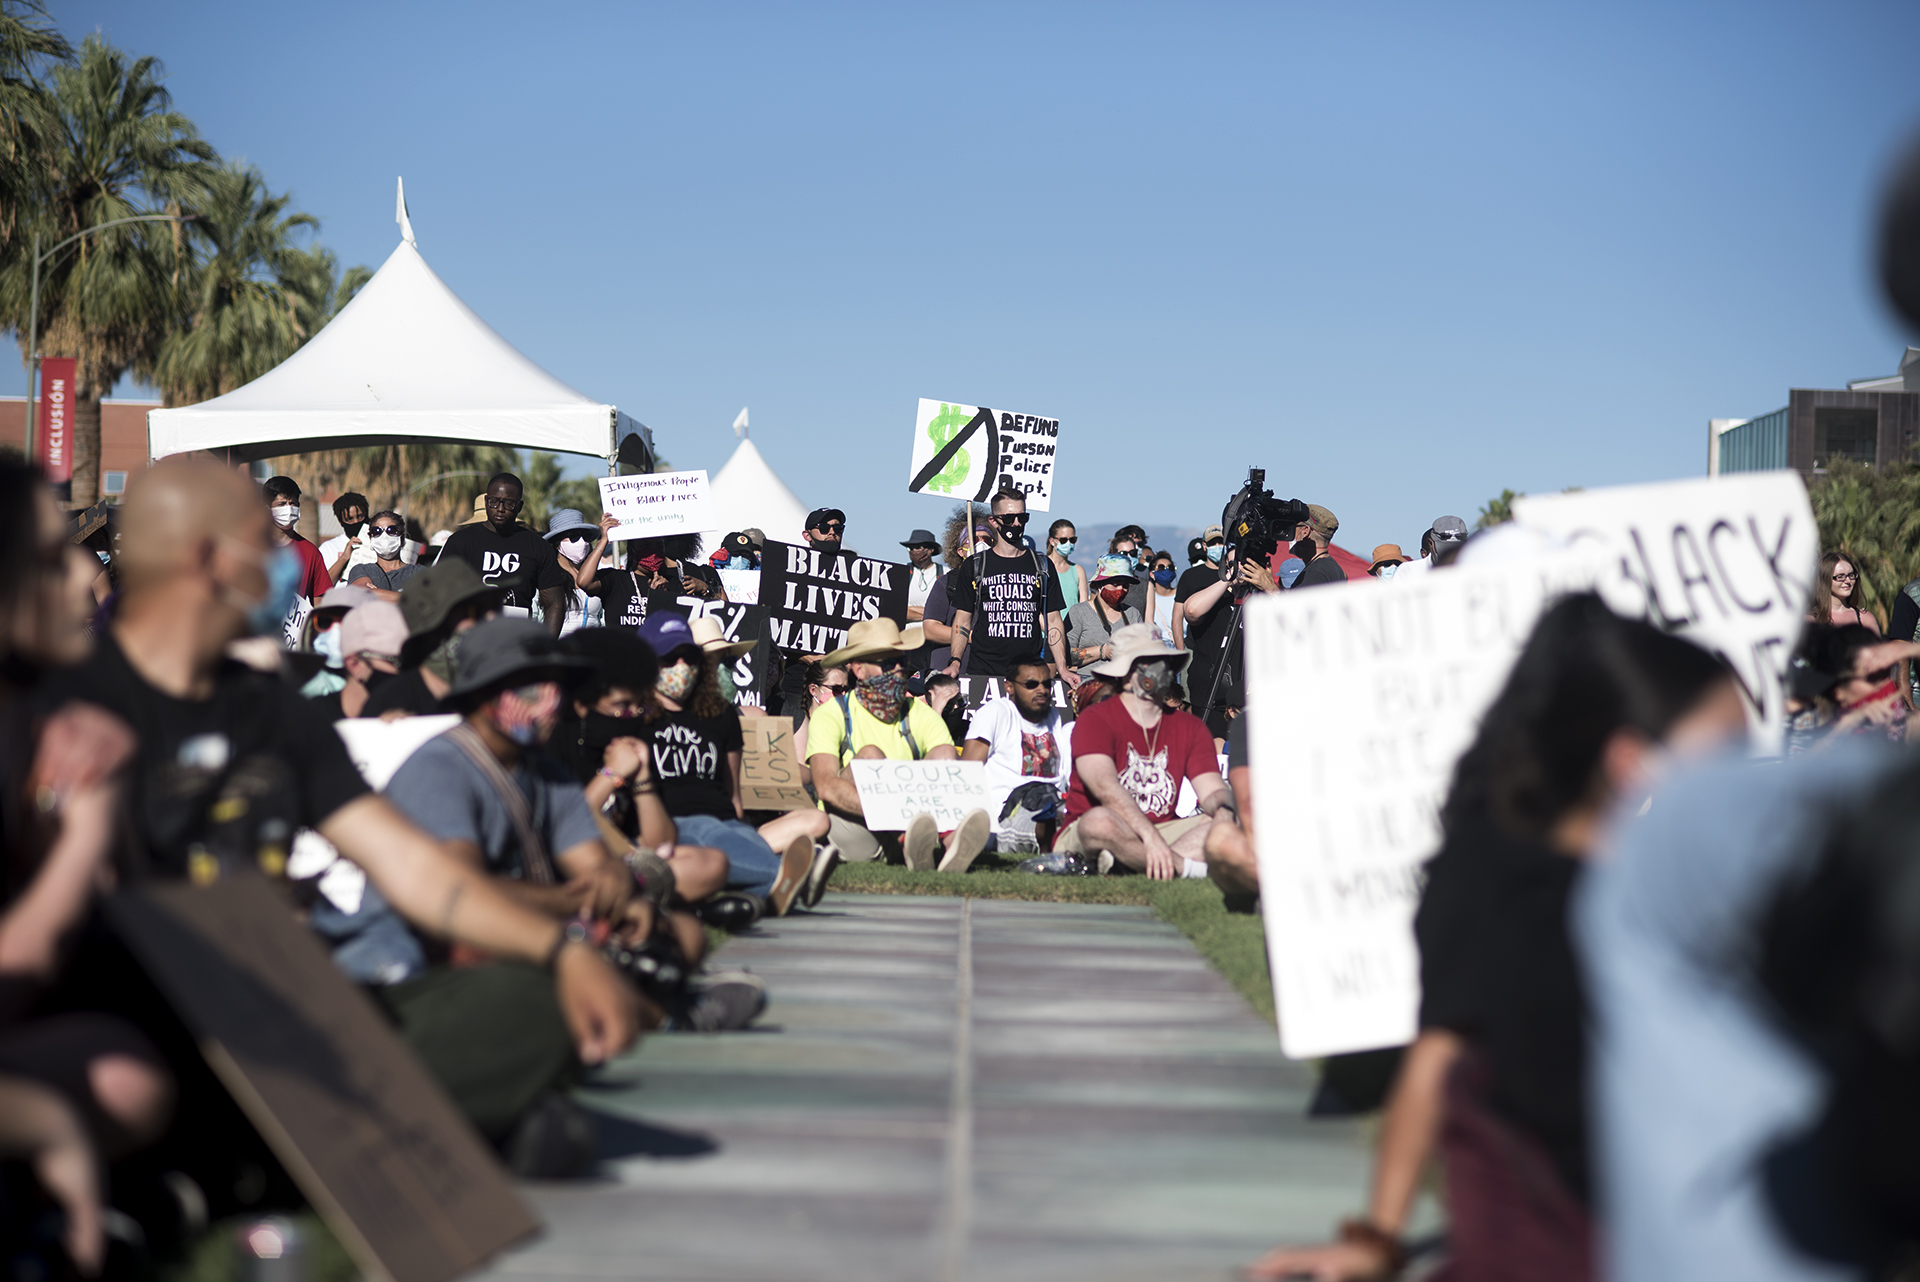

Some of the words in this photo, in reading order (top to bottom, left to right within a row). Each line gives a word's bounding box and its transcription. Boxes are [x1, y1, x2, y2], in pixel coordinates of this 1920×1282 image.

[49, 378, 65, 466] INCLUSIÓN
[603, 479, 667, 494] Indigenous
[482, 551, 521, 573] DG
[785, 545, 893, 591] BLACK
[982, 573, 1007, 586] WHITE
[1008, 573, 1036, 584] SILENC
[988, 584, 1034, 601] EQUALS
[783, 581, 880, 622] LIVES
[982, 601, 1005, 611] WHITE
[988, 612, 1012, 622] BLACK
[1013, 612, 1034, 622] LIVES
[769, 616, 849, 654] MATT
[988, 623, 1033, 638] MATTER
[867, 764, 967, 783] YOUR
[860, 783, 984, 796] HELICOPTERS
[905, 796, 944, 807] ARE
[900, 807, 966, 822] DMB
